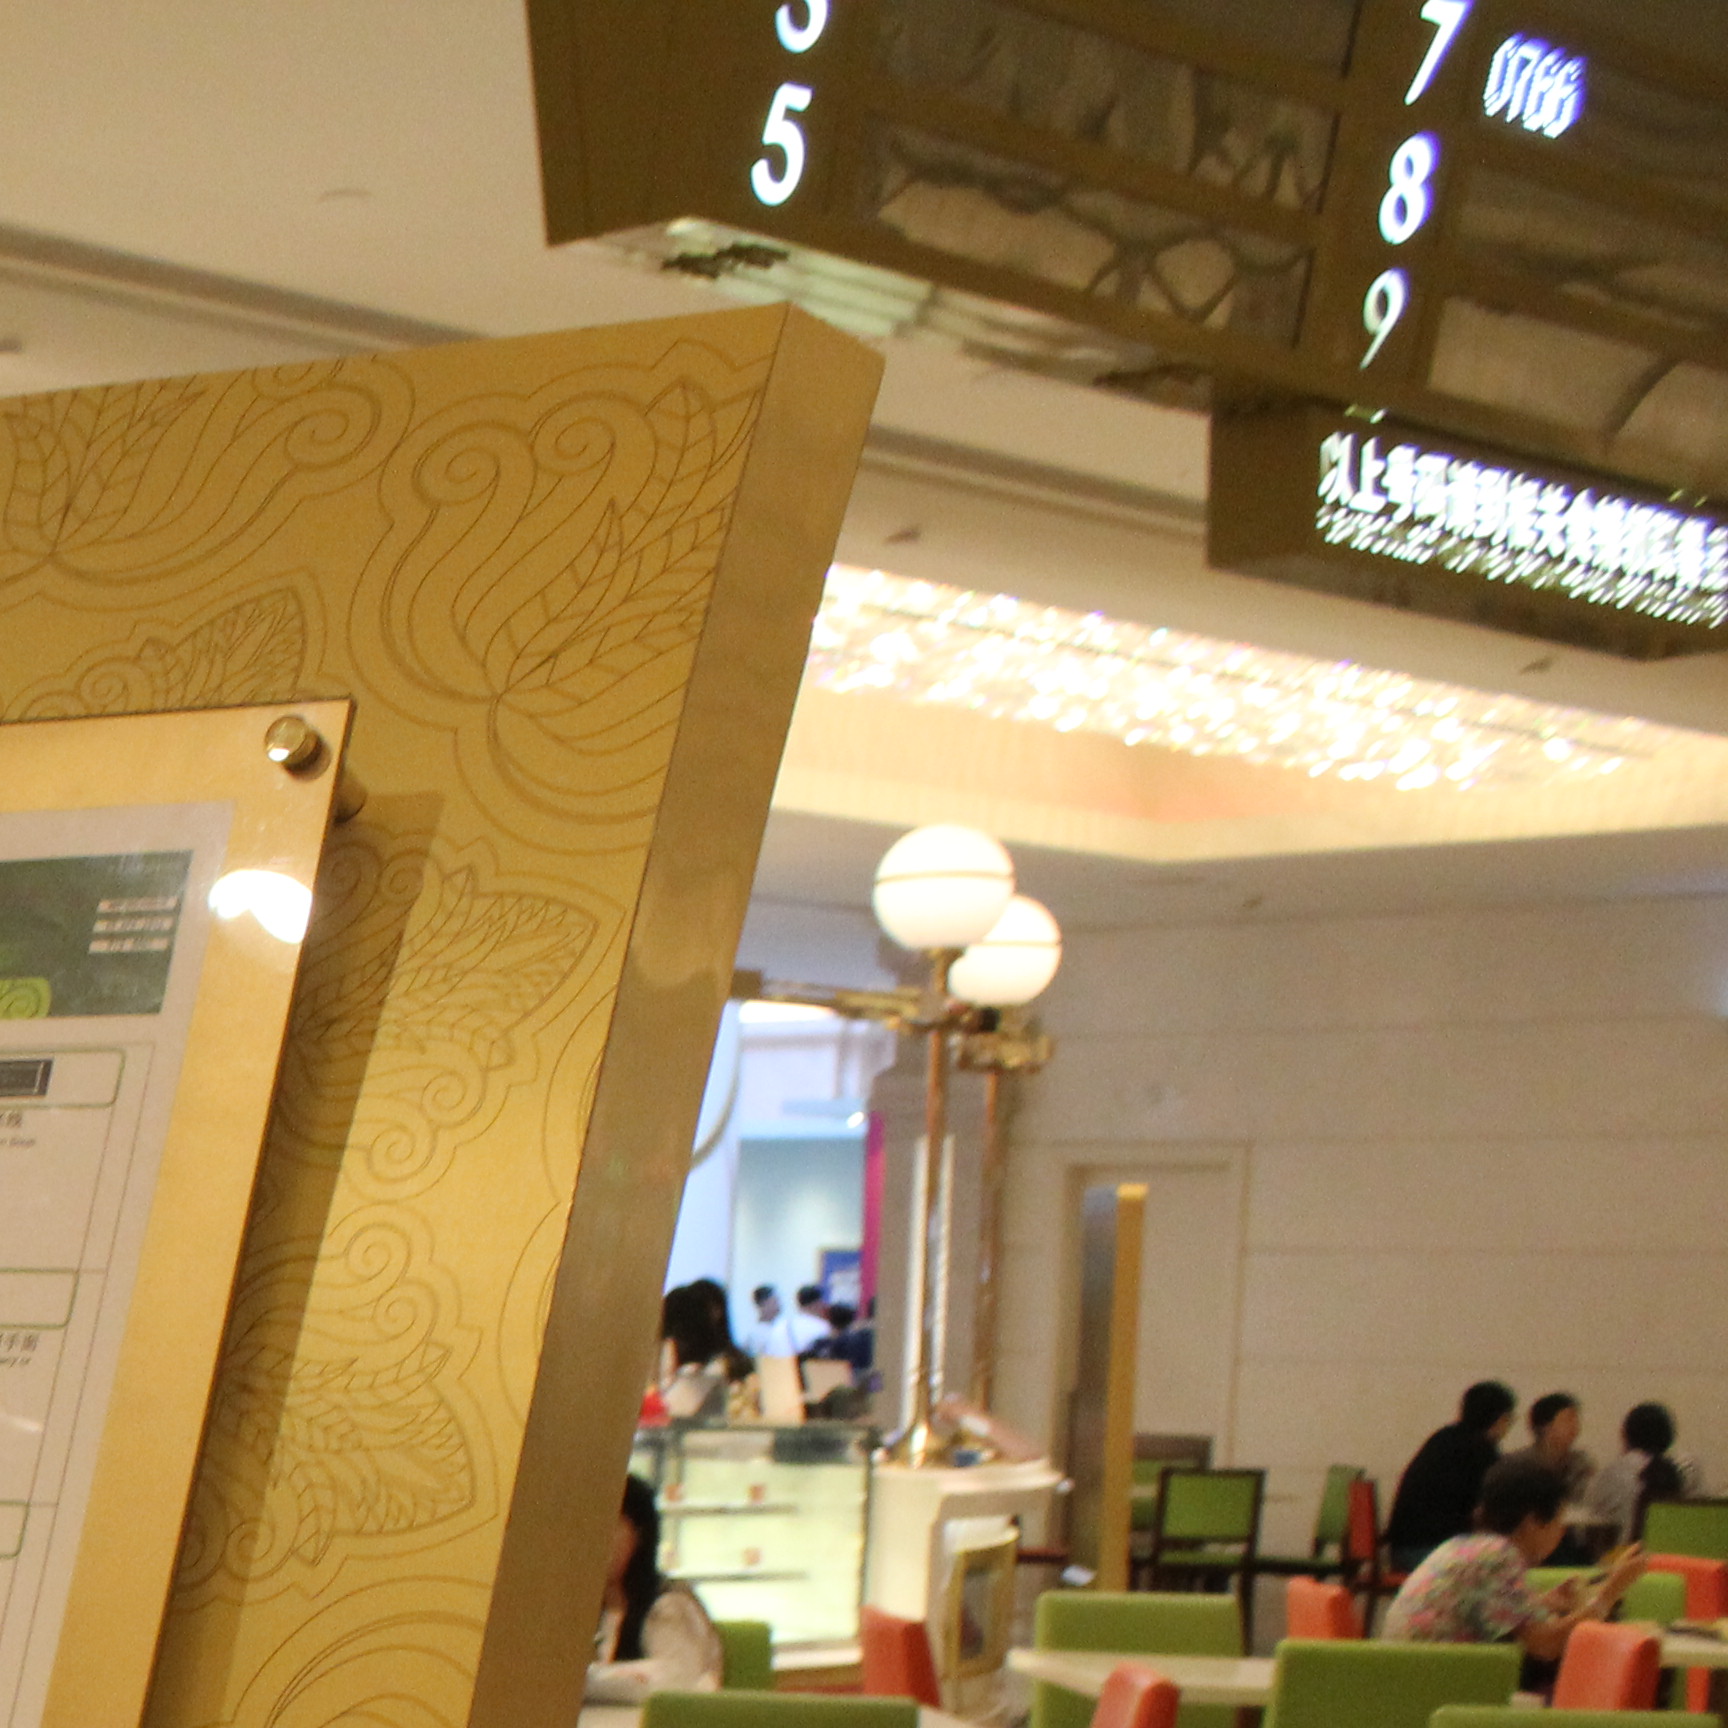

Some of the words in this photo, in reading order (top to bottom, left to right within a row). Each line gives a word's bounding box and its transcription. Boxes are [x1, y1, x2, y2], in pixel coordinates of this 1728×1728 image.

[750, 79, 816, 207] 5
[1378, 130, 1441, 246] 8
[1361, 266, 1411, 369] 9
